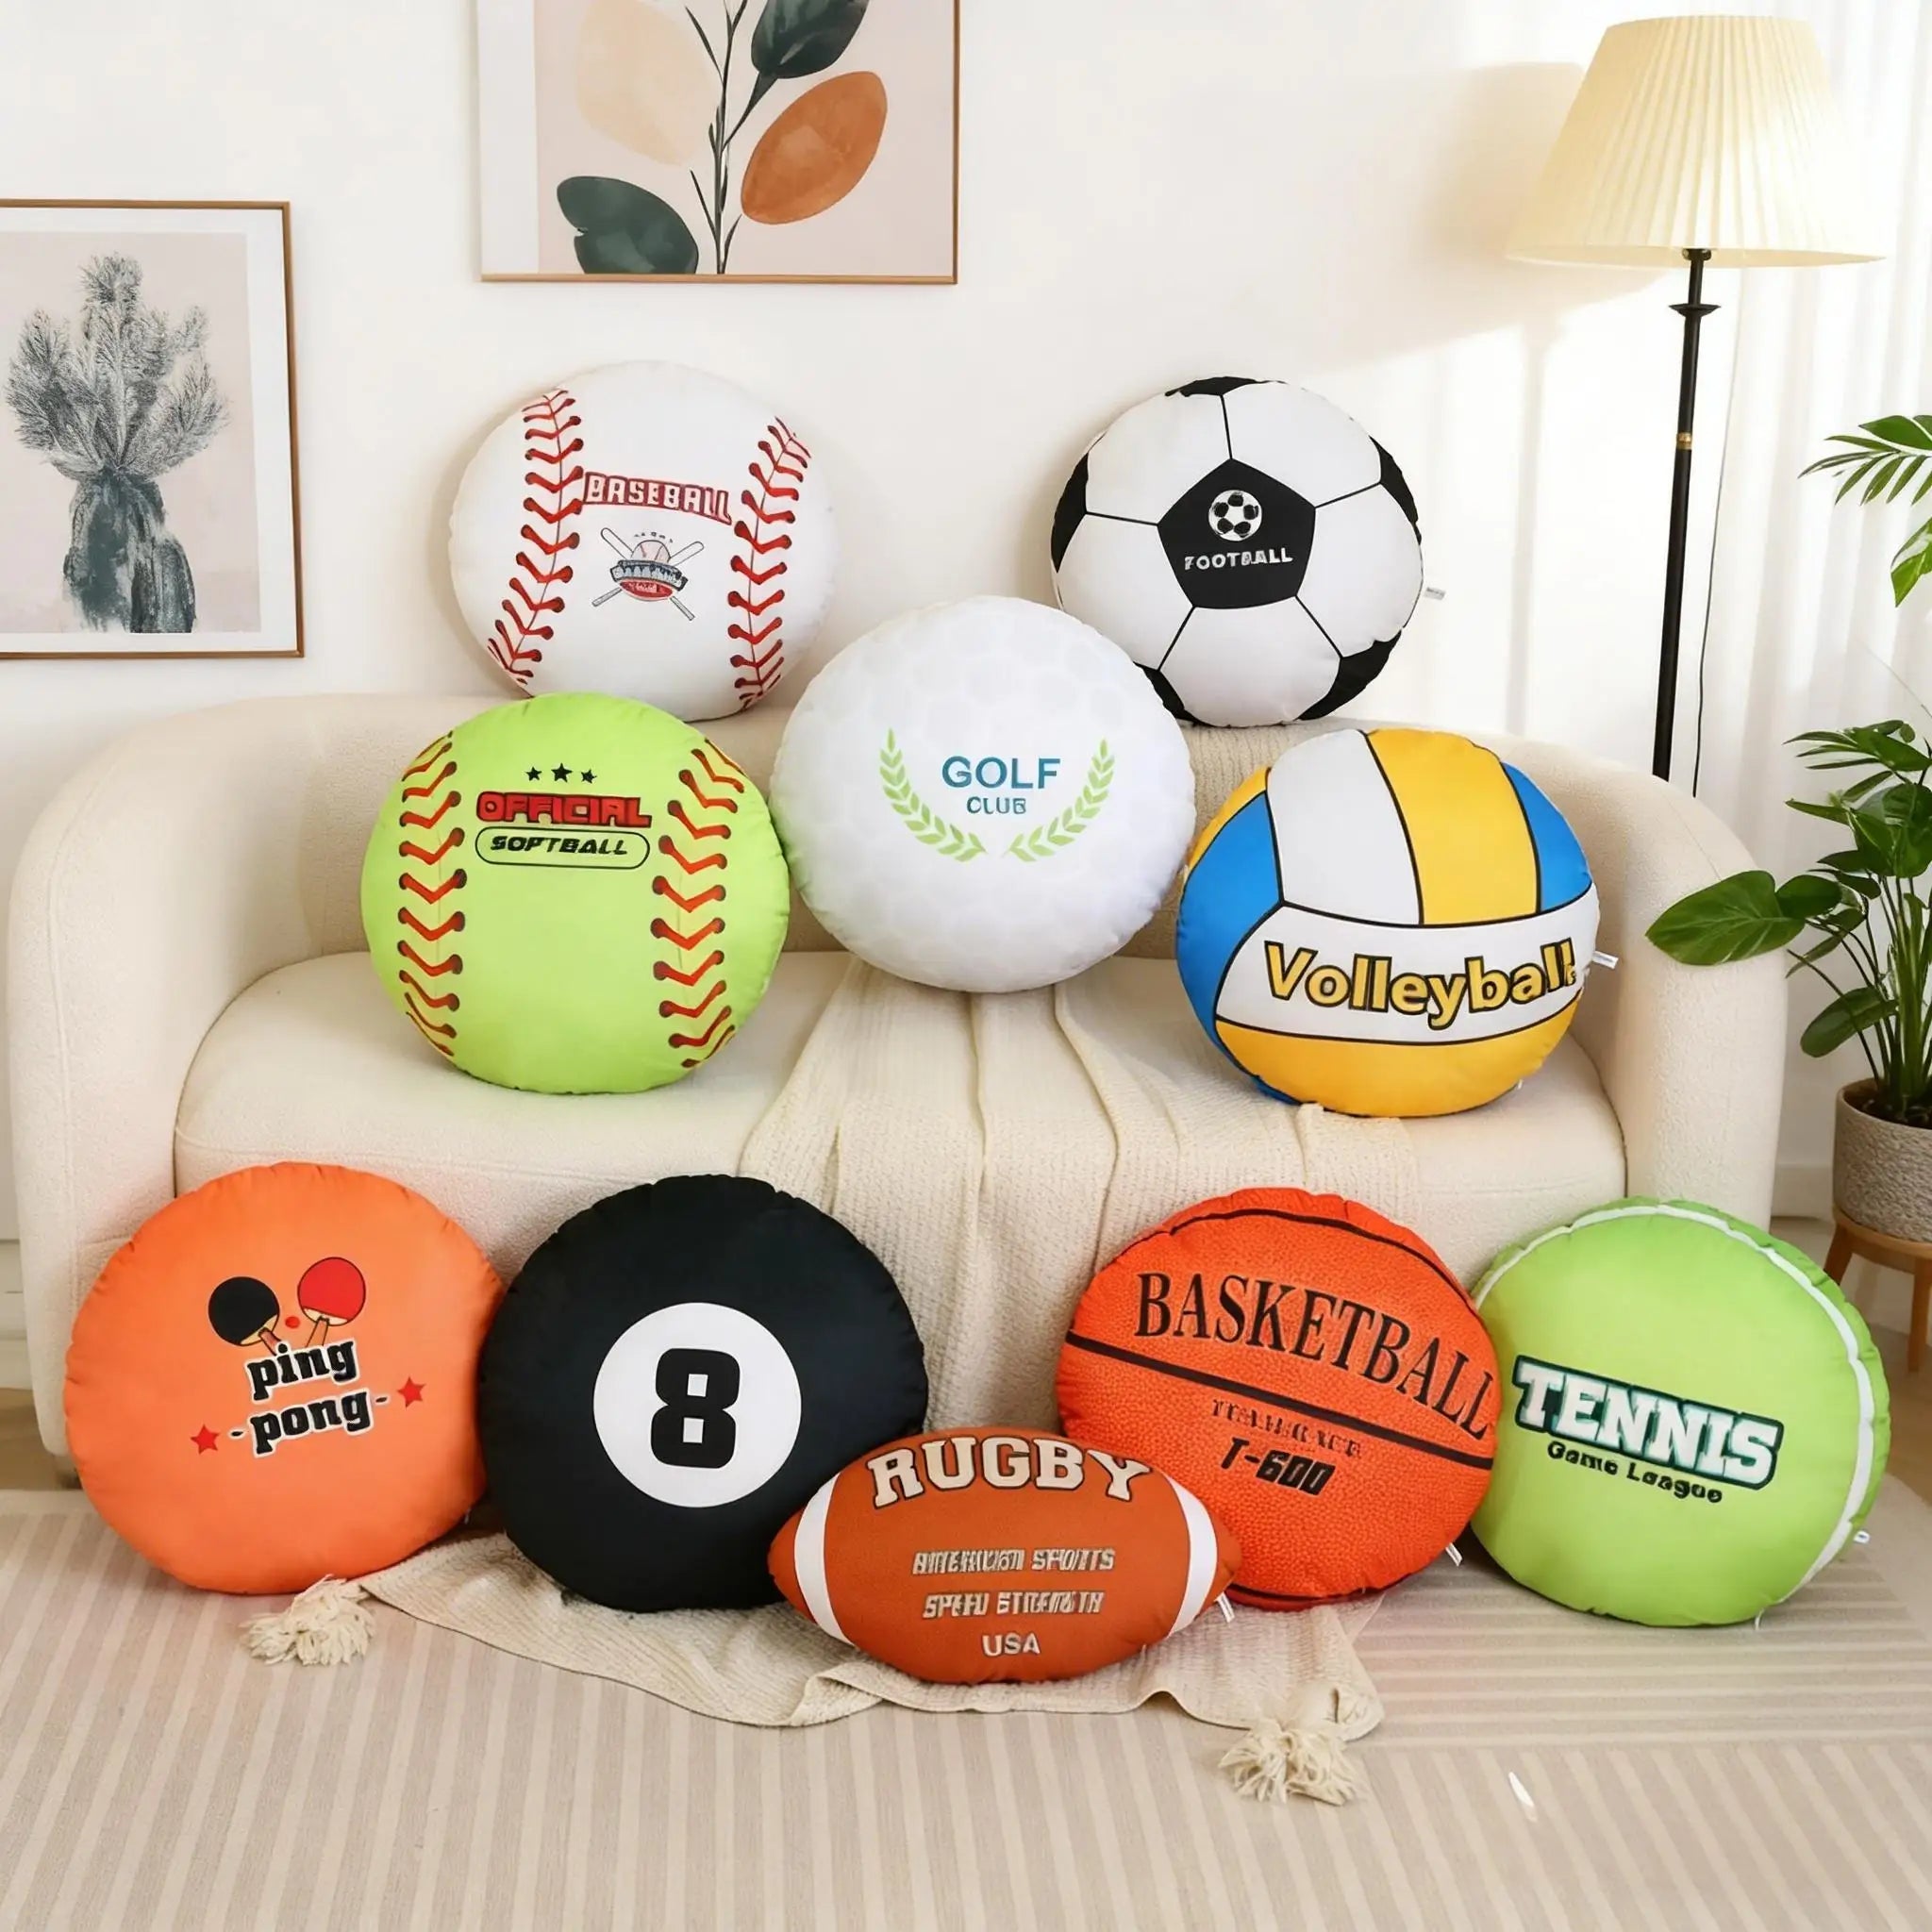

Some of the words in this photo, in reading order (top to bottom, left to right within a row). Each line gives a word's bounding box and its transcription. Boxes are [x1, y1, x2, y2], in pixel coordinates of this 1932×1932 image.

[583, 472, 732, 525] BASEBALL
[1184, 547, 1292, 570] FOOTBALL
[941, 756, 1060, 789] GOLF
[476, 791, 652, 828] OFFICIAL
[966, 796, 1026, 814] CLUB
[247, 1341, 354, 1401] ping
[1134, 1273, 1493, 1441] BASKETBALL
[651, 1348, 740, 1469] 8
[1512, 1355, 1784, 1491] TENNIS
[867, 1436, 1154, 1509] RUGBY
[1547, 1441, 1619, 1475] Game
[982, 1633, 1041, 1657] USA
